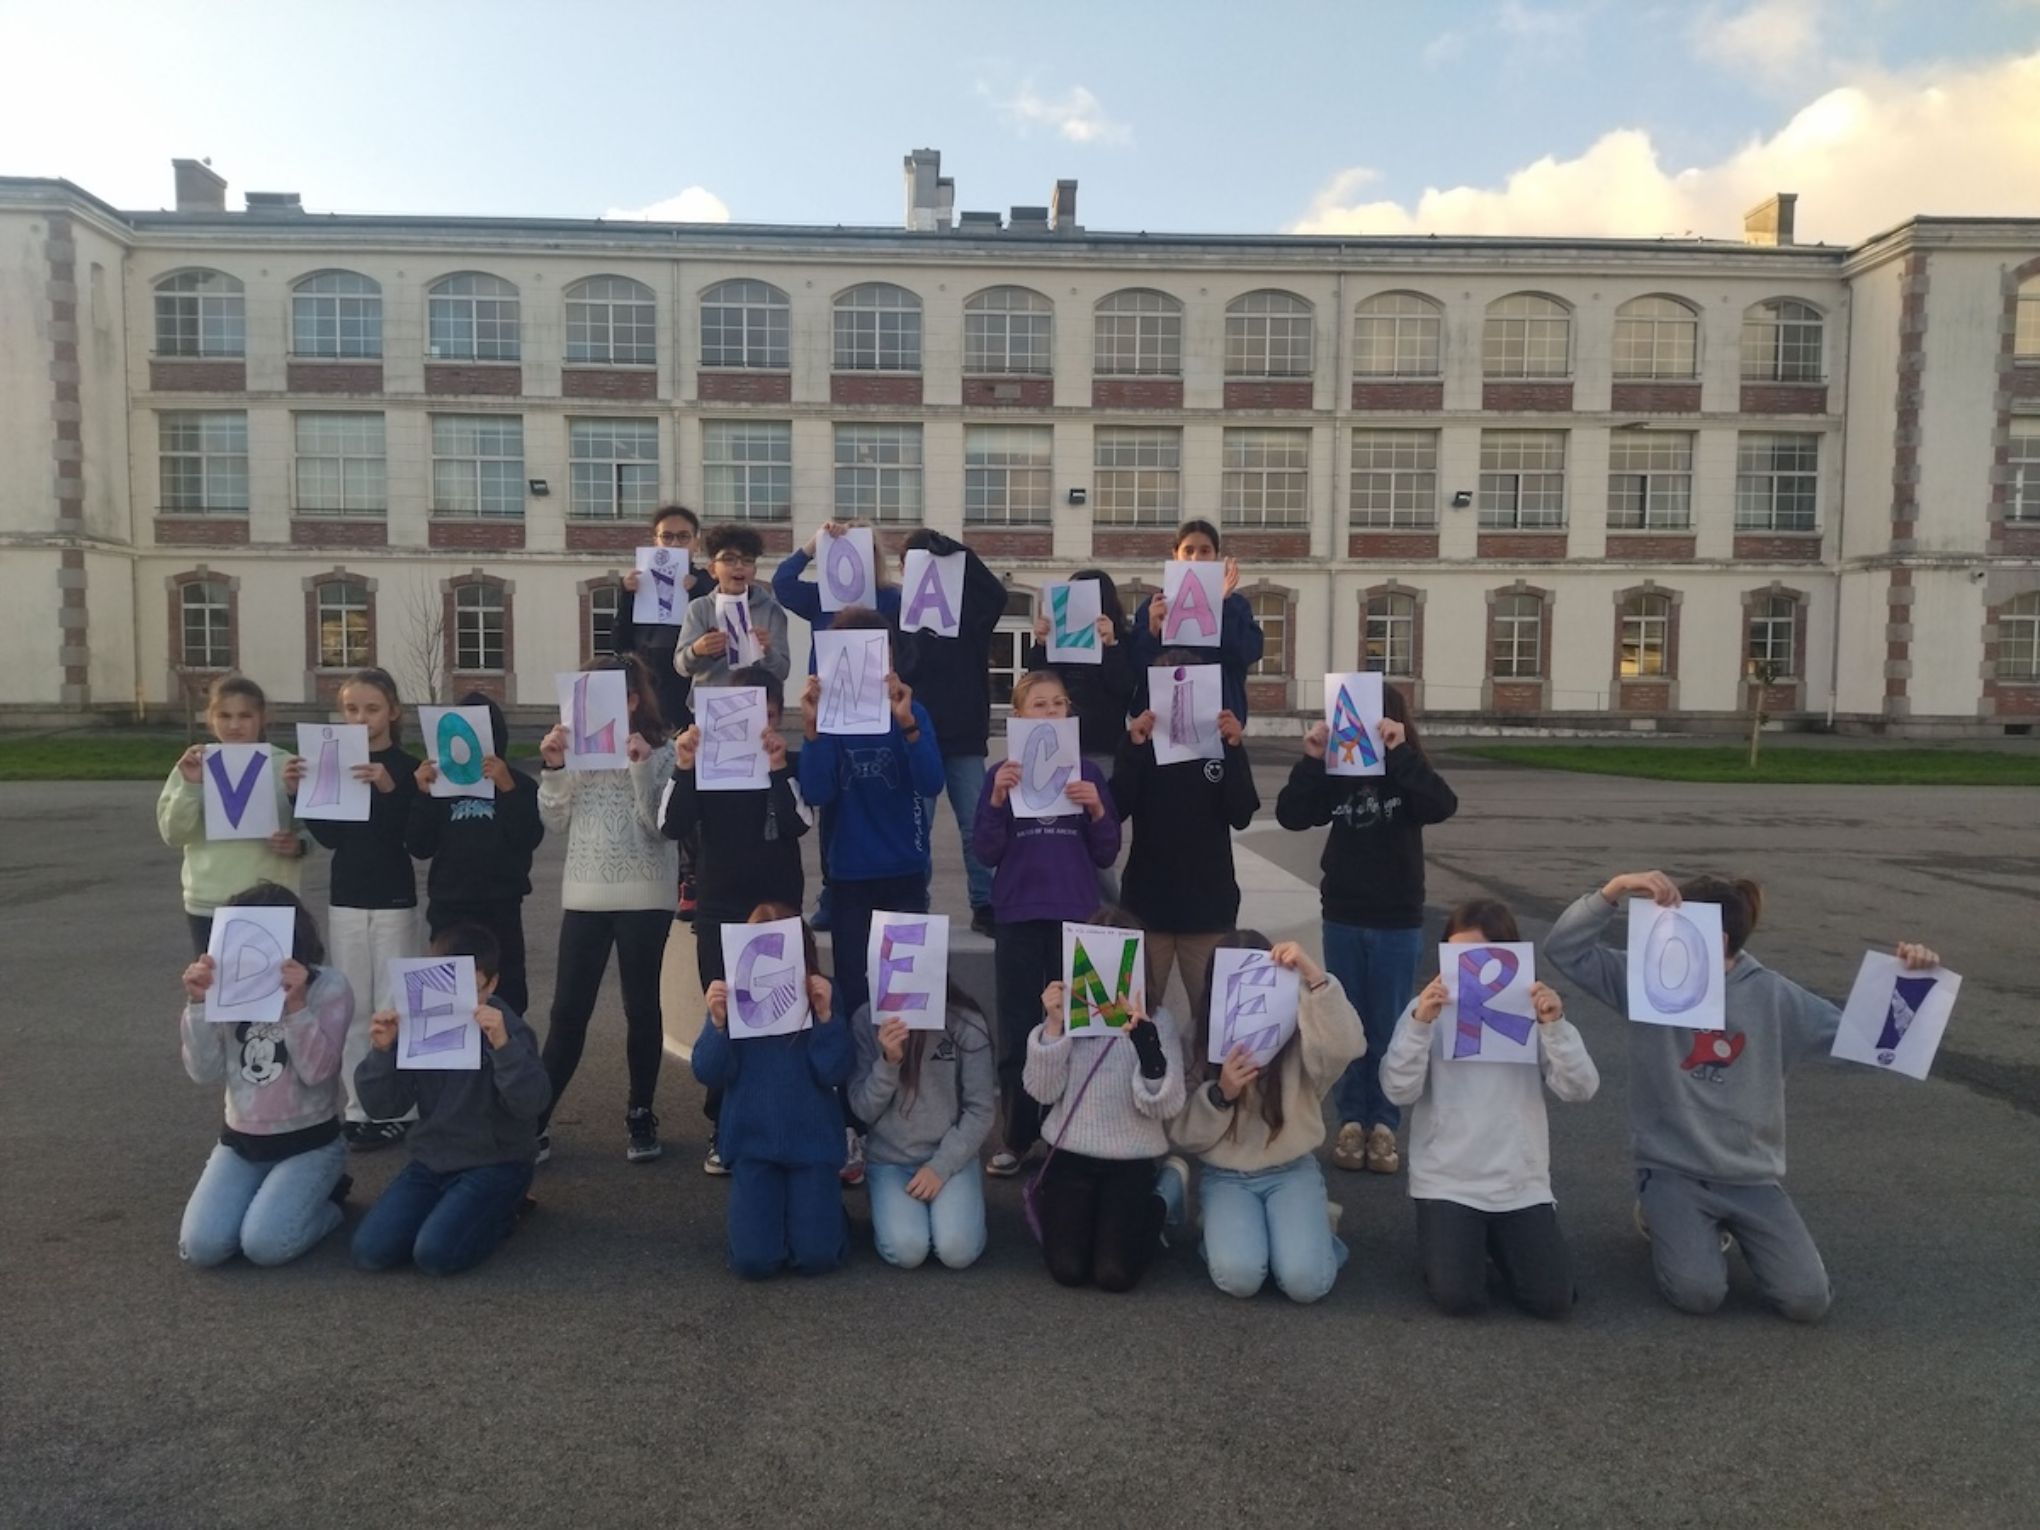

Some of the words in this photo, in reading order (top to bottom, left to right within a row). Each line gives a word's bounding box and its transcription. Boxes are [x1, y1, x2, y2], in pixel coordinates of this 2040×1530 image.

[825, 537, 866, 604] O
[904, 559, 957, 629] A
[1165, 568, 1218, 640] A
[1052, 585, 1100, 648] L
[574, 673, 616, 754] L
[821, 636, 887, 729] N
[1329, 683, 1380, 768] A
[437, 712, 482, 785] O
[702, 690, 757, 779] E
[1021, 722, 1075, 811] C
[206, 750, 268, 830] V
[218, 917, 283, 1008] D
[735, 932, 798, 1029] G
[878, 922, 929, 1012] E
[1069, 936, 1139, 1031] N
[1221, 953, 1281, 1056] É
[1453, 946, 1536, 1060] R
[1644, 910, 1710, 1015] O
[404, 962, 467, 1058] E
